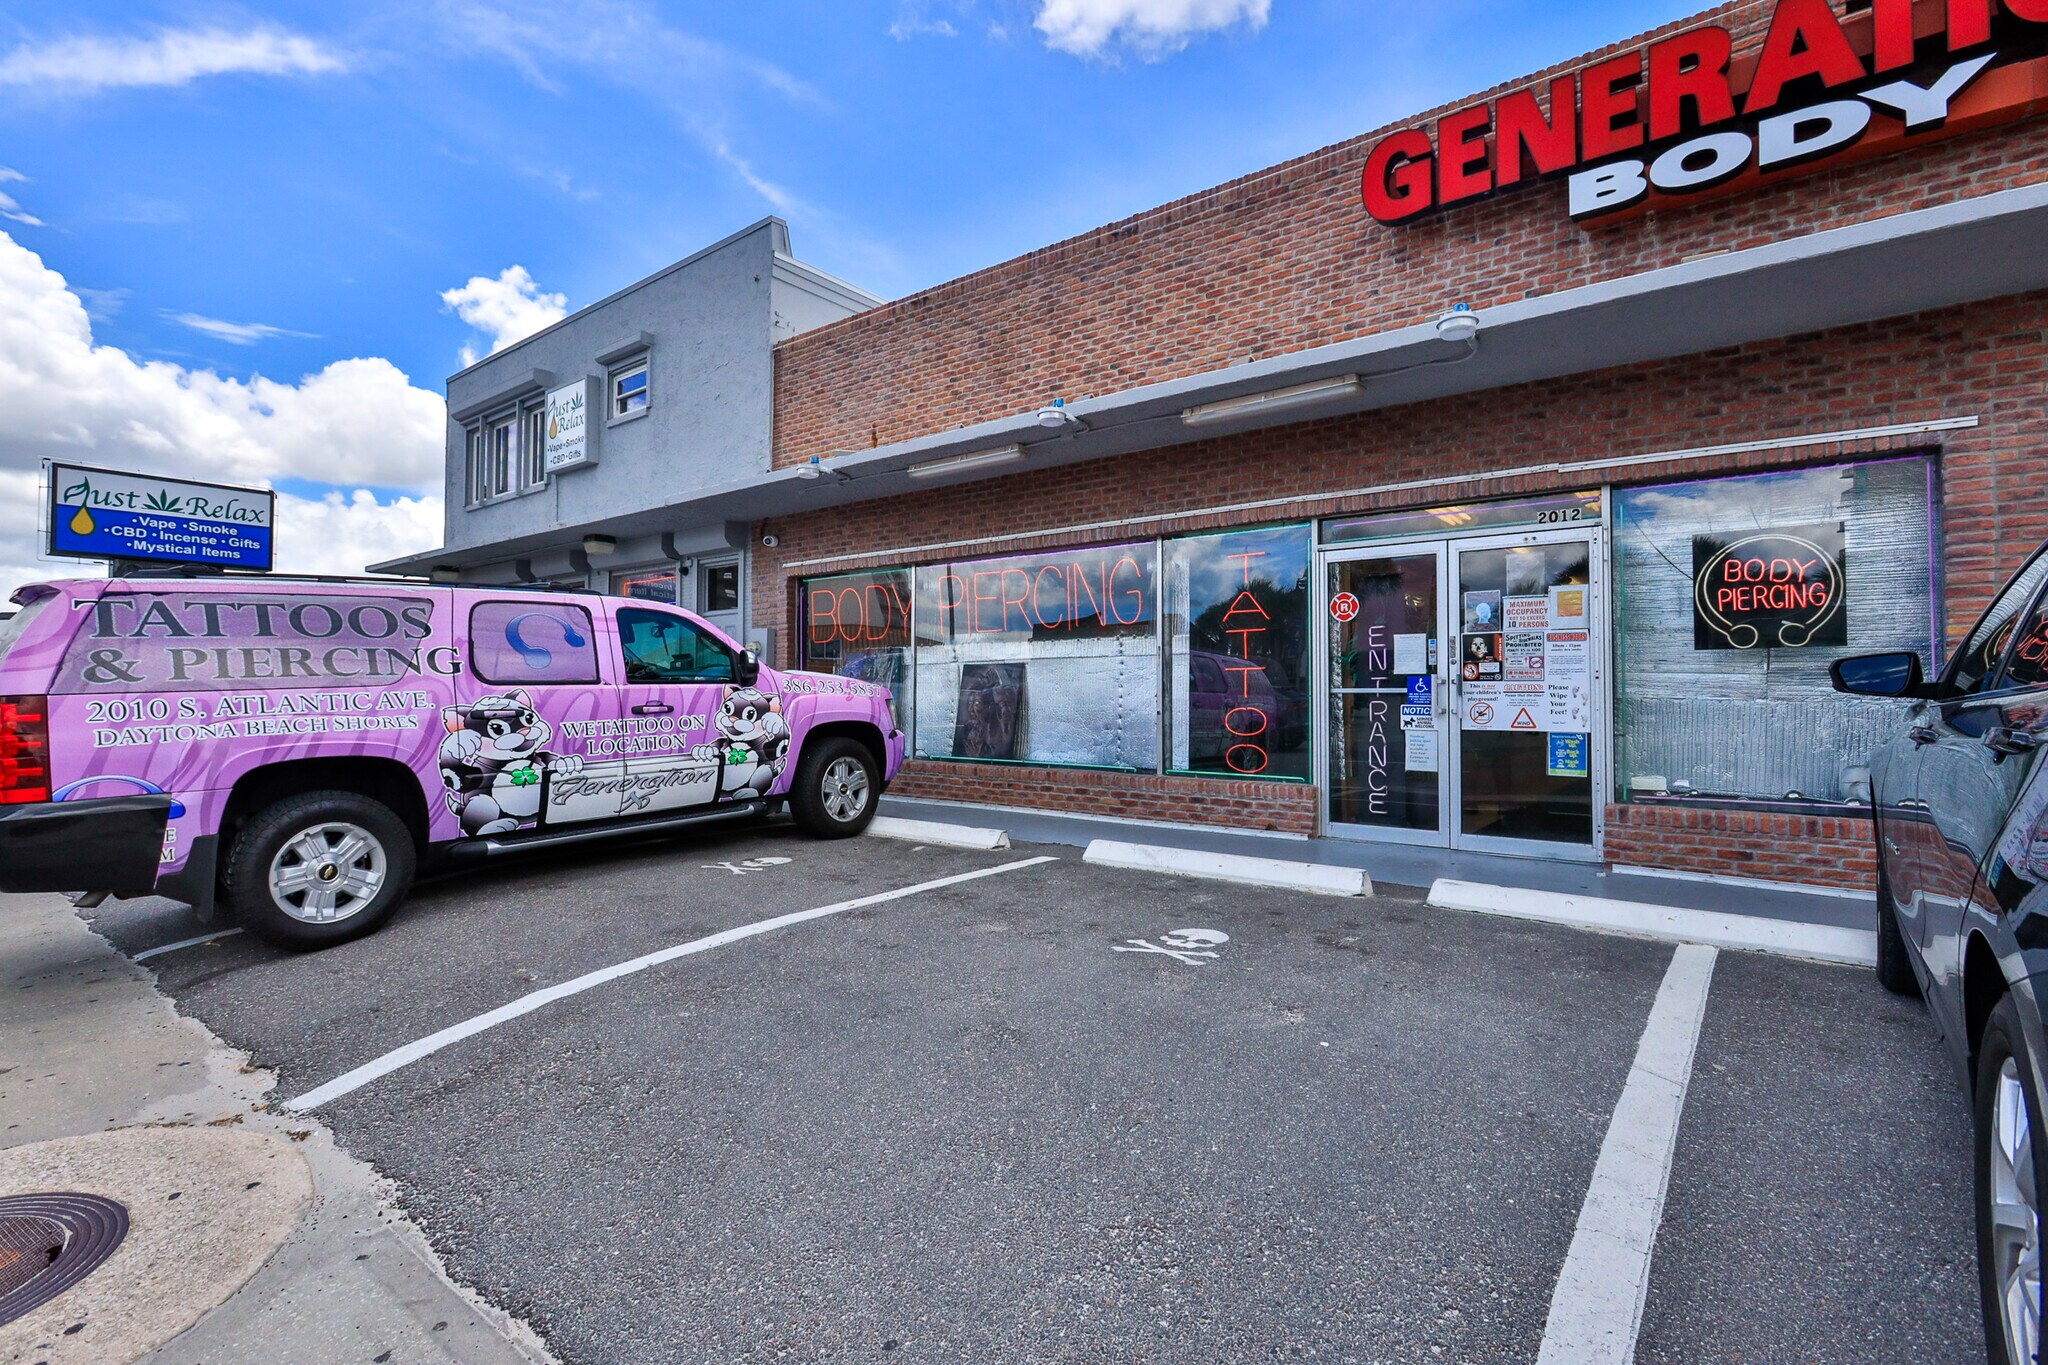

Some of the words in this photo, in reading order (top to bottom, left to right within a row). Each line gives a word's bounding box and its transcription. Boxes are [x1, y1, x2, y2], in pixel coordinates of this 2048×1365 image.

[1361, 0, 2048, 222] GENERAT
[1568, 51, 1999, 217] BODY
[558, 410, 585, 433] Relax
[549, 442, 563, 453] Vape
[565, 435, 585, 448] Smoke
[552, 453, 566, 465] CBD
[569, 450, 582, 460] Gifts
[185, 496, 265, 524] Relax
[1538, 509, 1581, 524] 2012
[110, 525, 148, 539] CBD
[159, 530, 218, 545] Incense
[228, 537, 261, 550] Gifts
[138, 516, 177, 530] Vape
[188, 521, 239, 536] Smoke
[133, 540, 197, 555] Mystical
[202, 546, 241, 559] Items
[1724, 558, 1817, 583] BODY
[811, 583, 913, 644] BODY
[939, 557, 1143, 638] PIERCING
[1509, 600, 1545, 608] MAXIMUM
[1717, 582, 1828, 613] PIERCING
[73, 599, 433, 640] TATTOOS
[1518, 620, 1549, 628] PERSONS
[82, 645, 146, 685] &
[167, 646, 463, 682] PIERCING
[1223, 551, 1270, 774] TATTOO
[85, 698, 170, 724] 2010
[177, 696, 207, 720] S.
[216, 692, 375, 718] ATLANTIC
[376, 690, 436, 711] AVE.
[1368, 625, 1388, 814] ENTRANCE
[94, 722, 239, 747] DAYTONA
[243, 716, 329, 738] BEACH
[334, 714, 420, 732] SHORES
[561, 721, 596, 738] WE
[596, 716, 674, 737] TATTOO
[678, 713, 706, 730] ON
[586, 732, 687, 756] LOCATION
